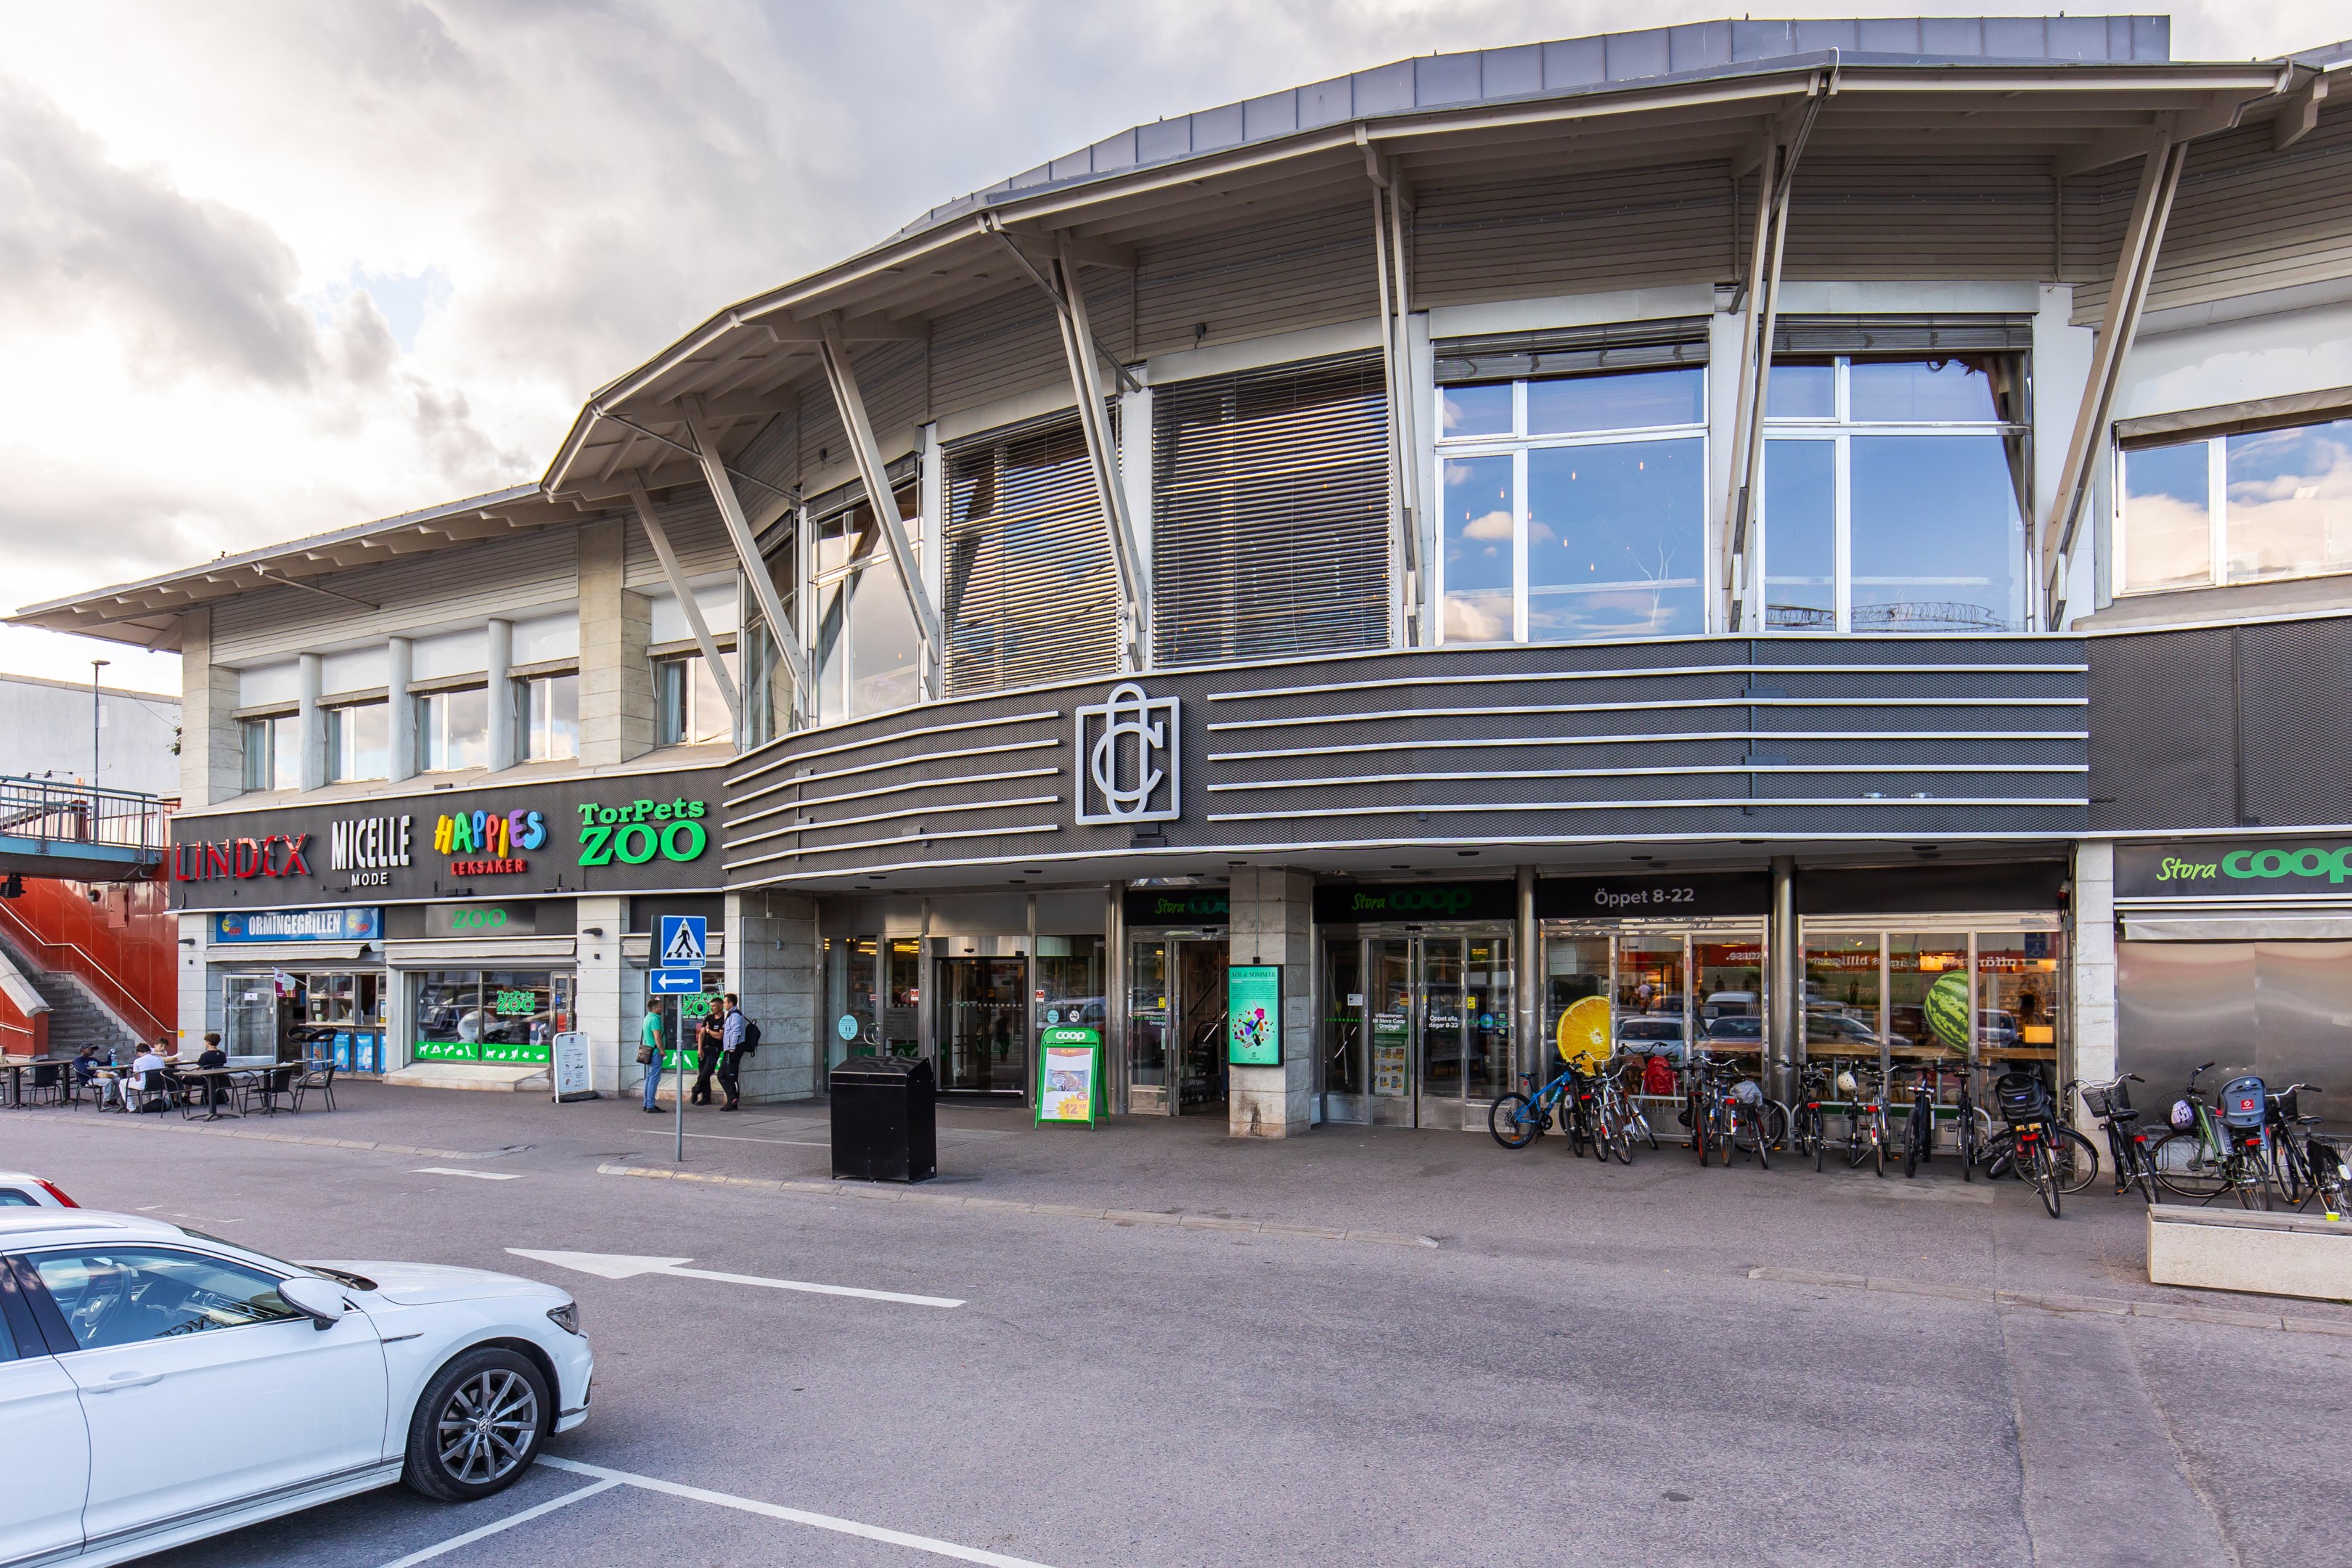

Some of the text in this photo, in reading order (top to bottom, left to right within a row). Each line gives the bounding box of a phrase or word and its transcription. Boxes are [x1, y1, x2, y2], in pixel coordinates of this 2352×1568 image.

[578, 797, 705, 825] TorPets
[331, 814, 410, 870] MICELLE
[434, 809, 547, 859] HAPPIES
[578, 820, 706, 866] ZOO
[176, 833, 311, 881] LINDEX
[451, 858, 527, 875] LEKSAKER
[351, 872, 388, 886] MODE
[2156, 857, 2217, 881] Stora
[1155, 894, 1230, 915] Stora coo
[1351, 887, 1472, 915] Stora coop
[1594, 888, 1694, 907] Öppet 8-22
[248, 912, 341, 936] ORMINGEGRILLEN
[452, 908, 507, 928] ZOO
[497, 990, 535, 999] TorPets
[497, 998, 535, 1012] ZOO
[1055, 1031, 1086, 1042] coop
[1064, 1103, 1078, 1114] 12
